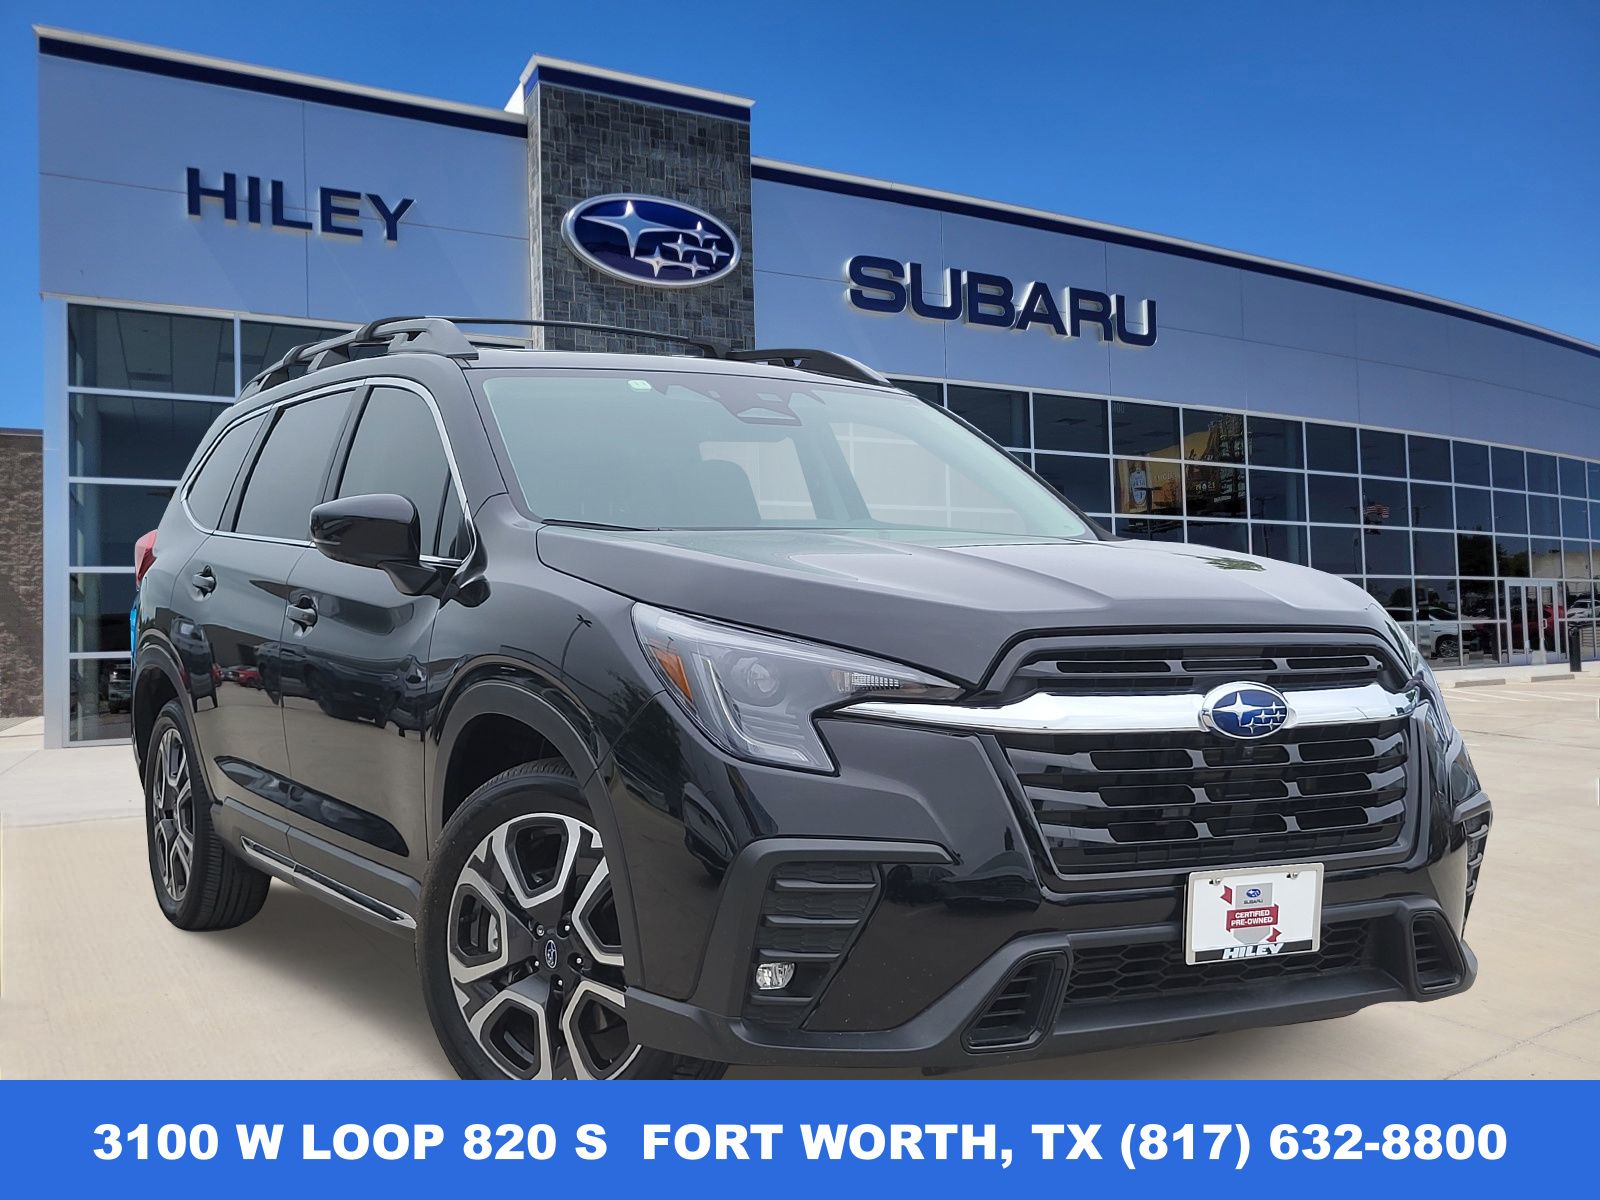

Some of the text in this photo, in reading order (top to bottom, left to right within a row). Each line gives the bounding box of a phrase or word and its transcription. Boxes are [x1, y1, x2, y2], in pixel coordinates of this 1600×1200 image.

[187, 167, 414, 241] HILEY
[849, 255, 1157, 346] SUBARU
[1231, 916, 1273, 926] PRE-OWNED
[1235, 909, 1270, 919] CERTIFIED
[1222, 943, 1284, 959] HILEY
